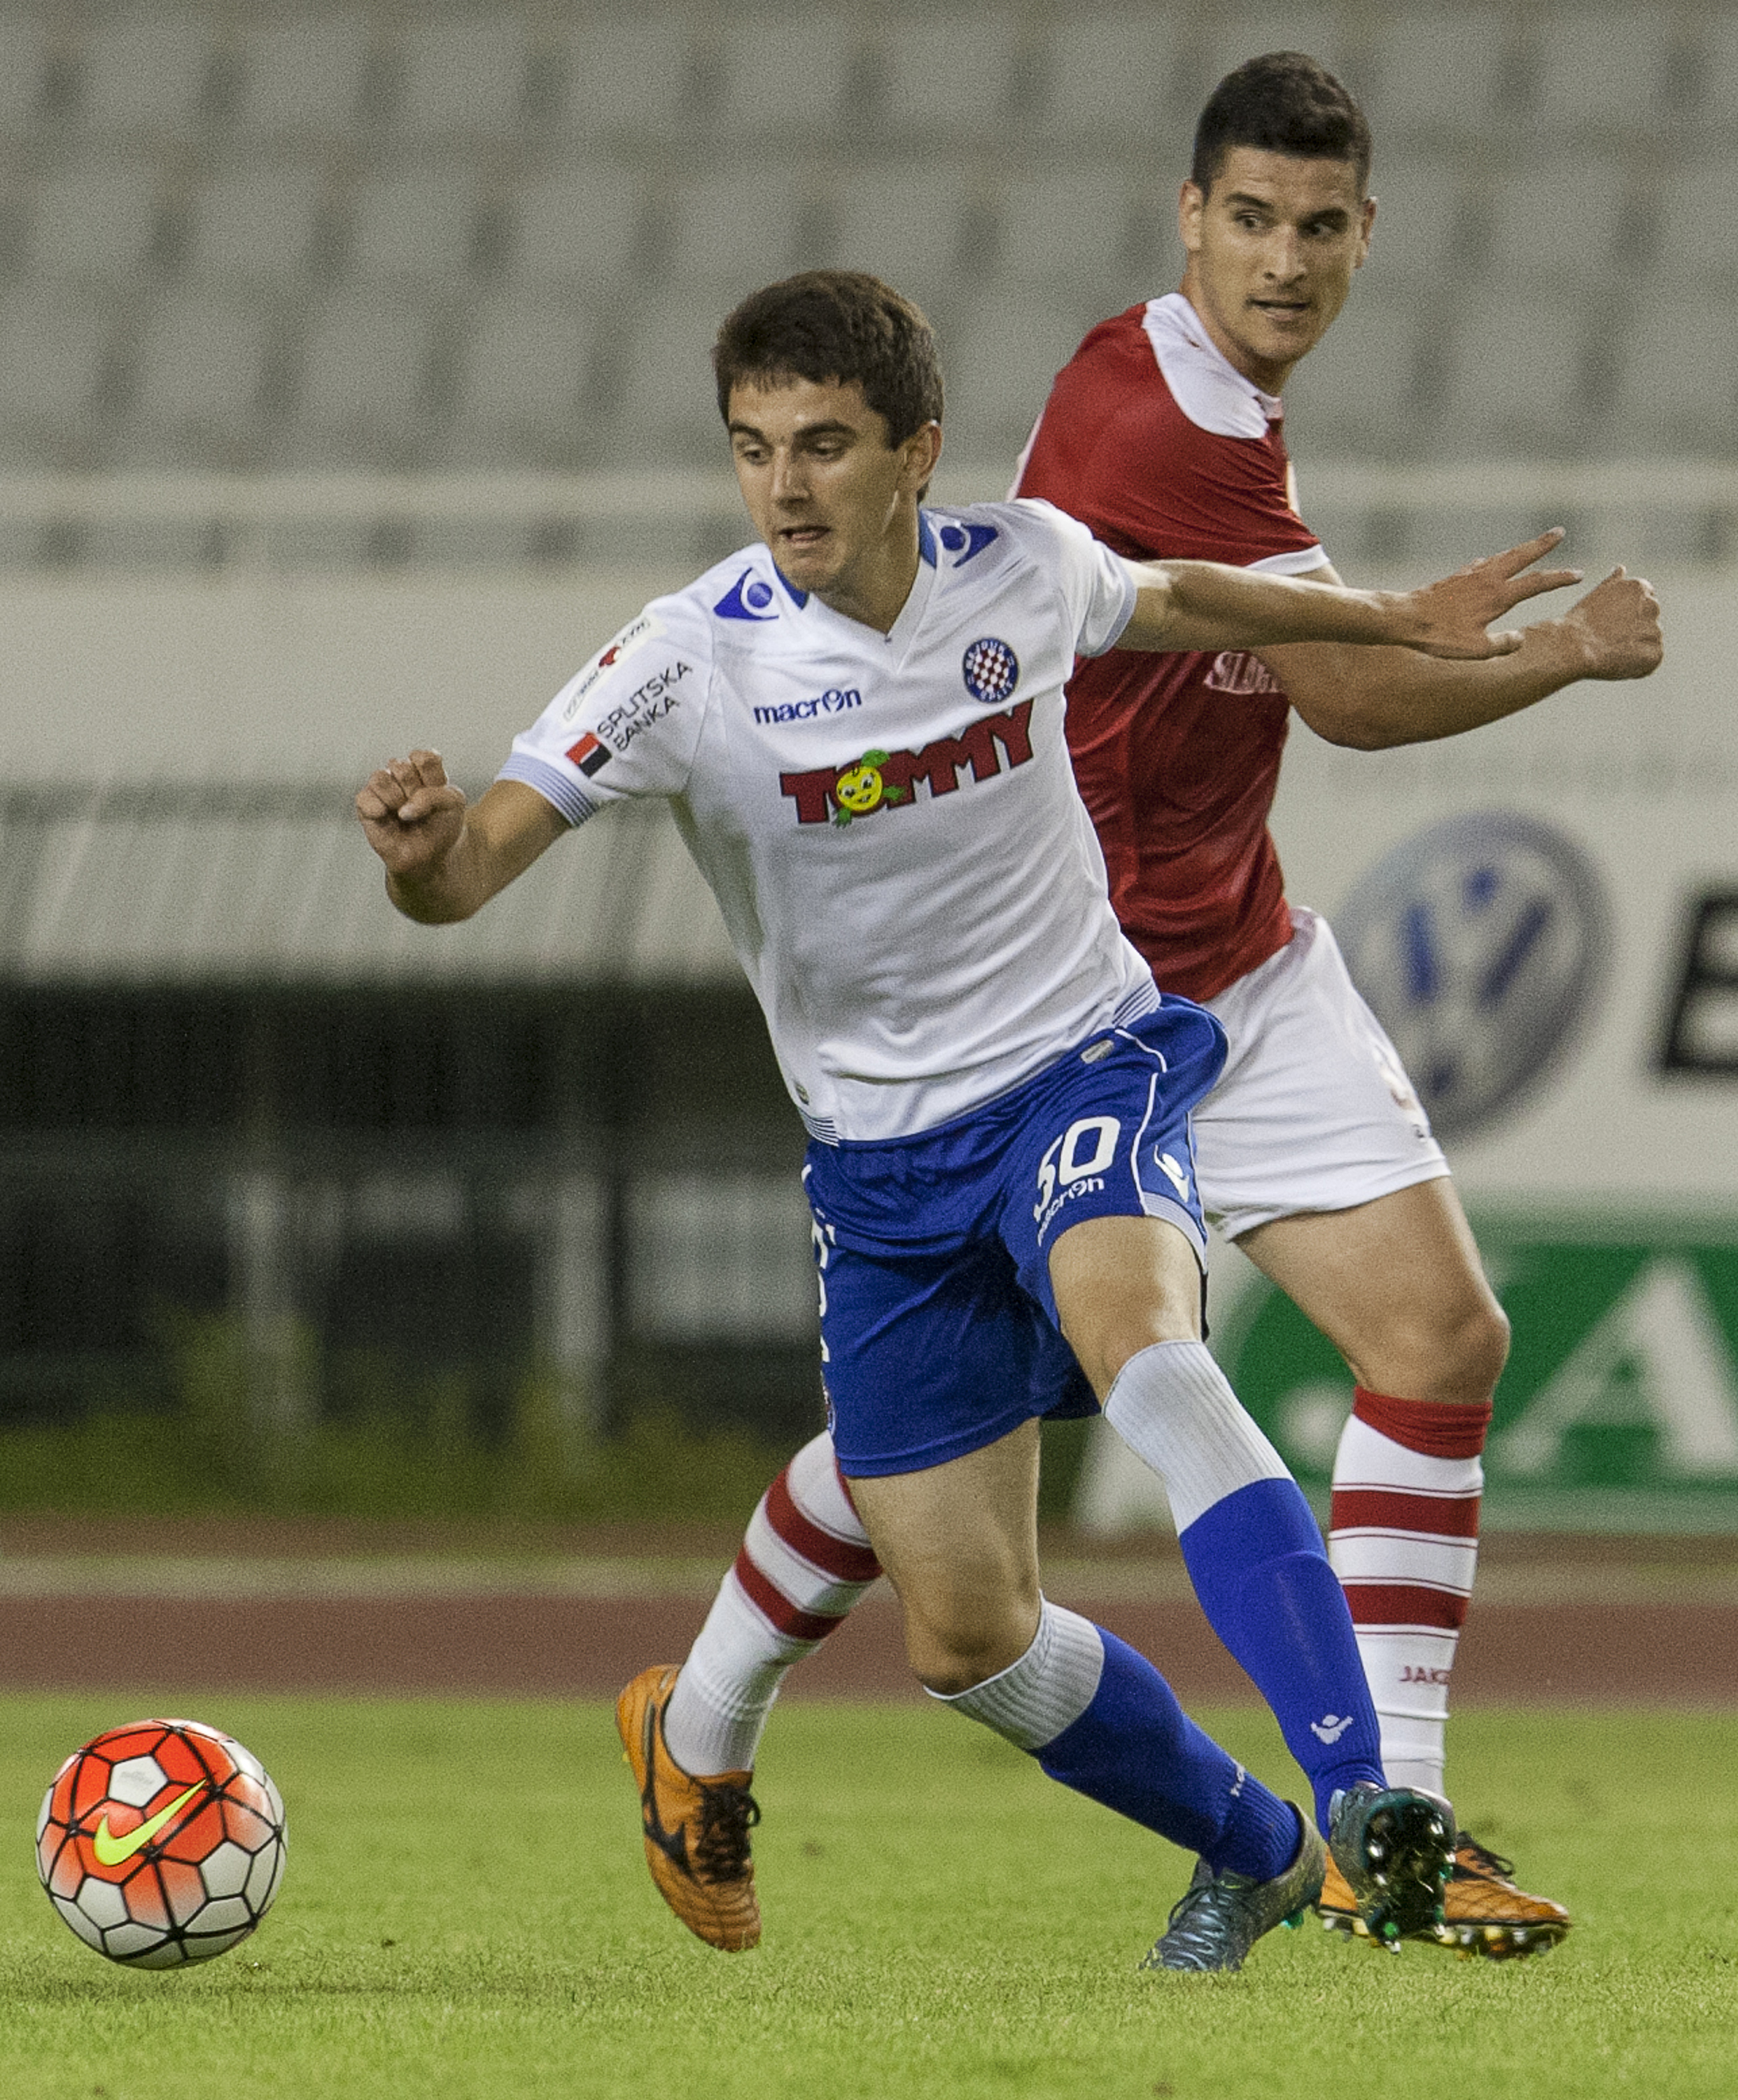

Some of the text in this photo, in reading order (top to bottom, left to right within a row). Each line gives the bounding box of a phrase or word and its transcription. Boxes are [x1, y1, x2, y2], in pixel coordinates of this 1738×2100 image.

[597, 661, 693, 739] SPLITSKA
[613, 695, 680, 752] BANKA
[753, 688, 862, 724] macron
[779, 698, 1034, 825] TOMMY
